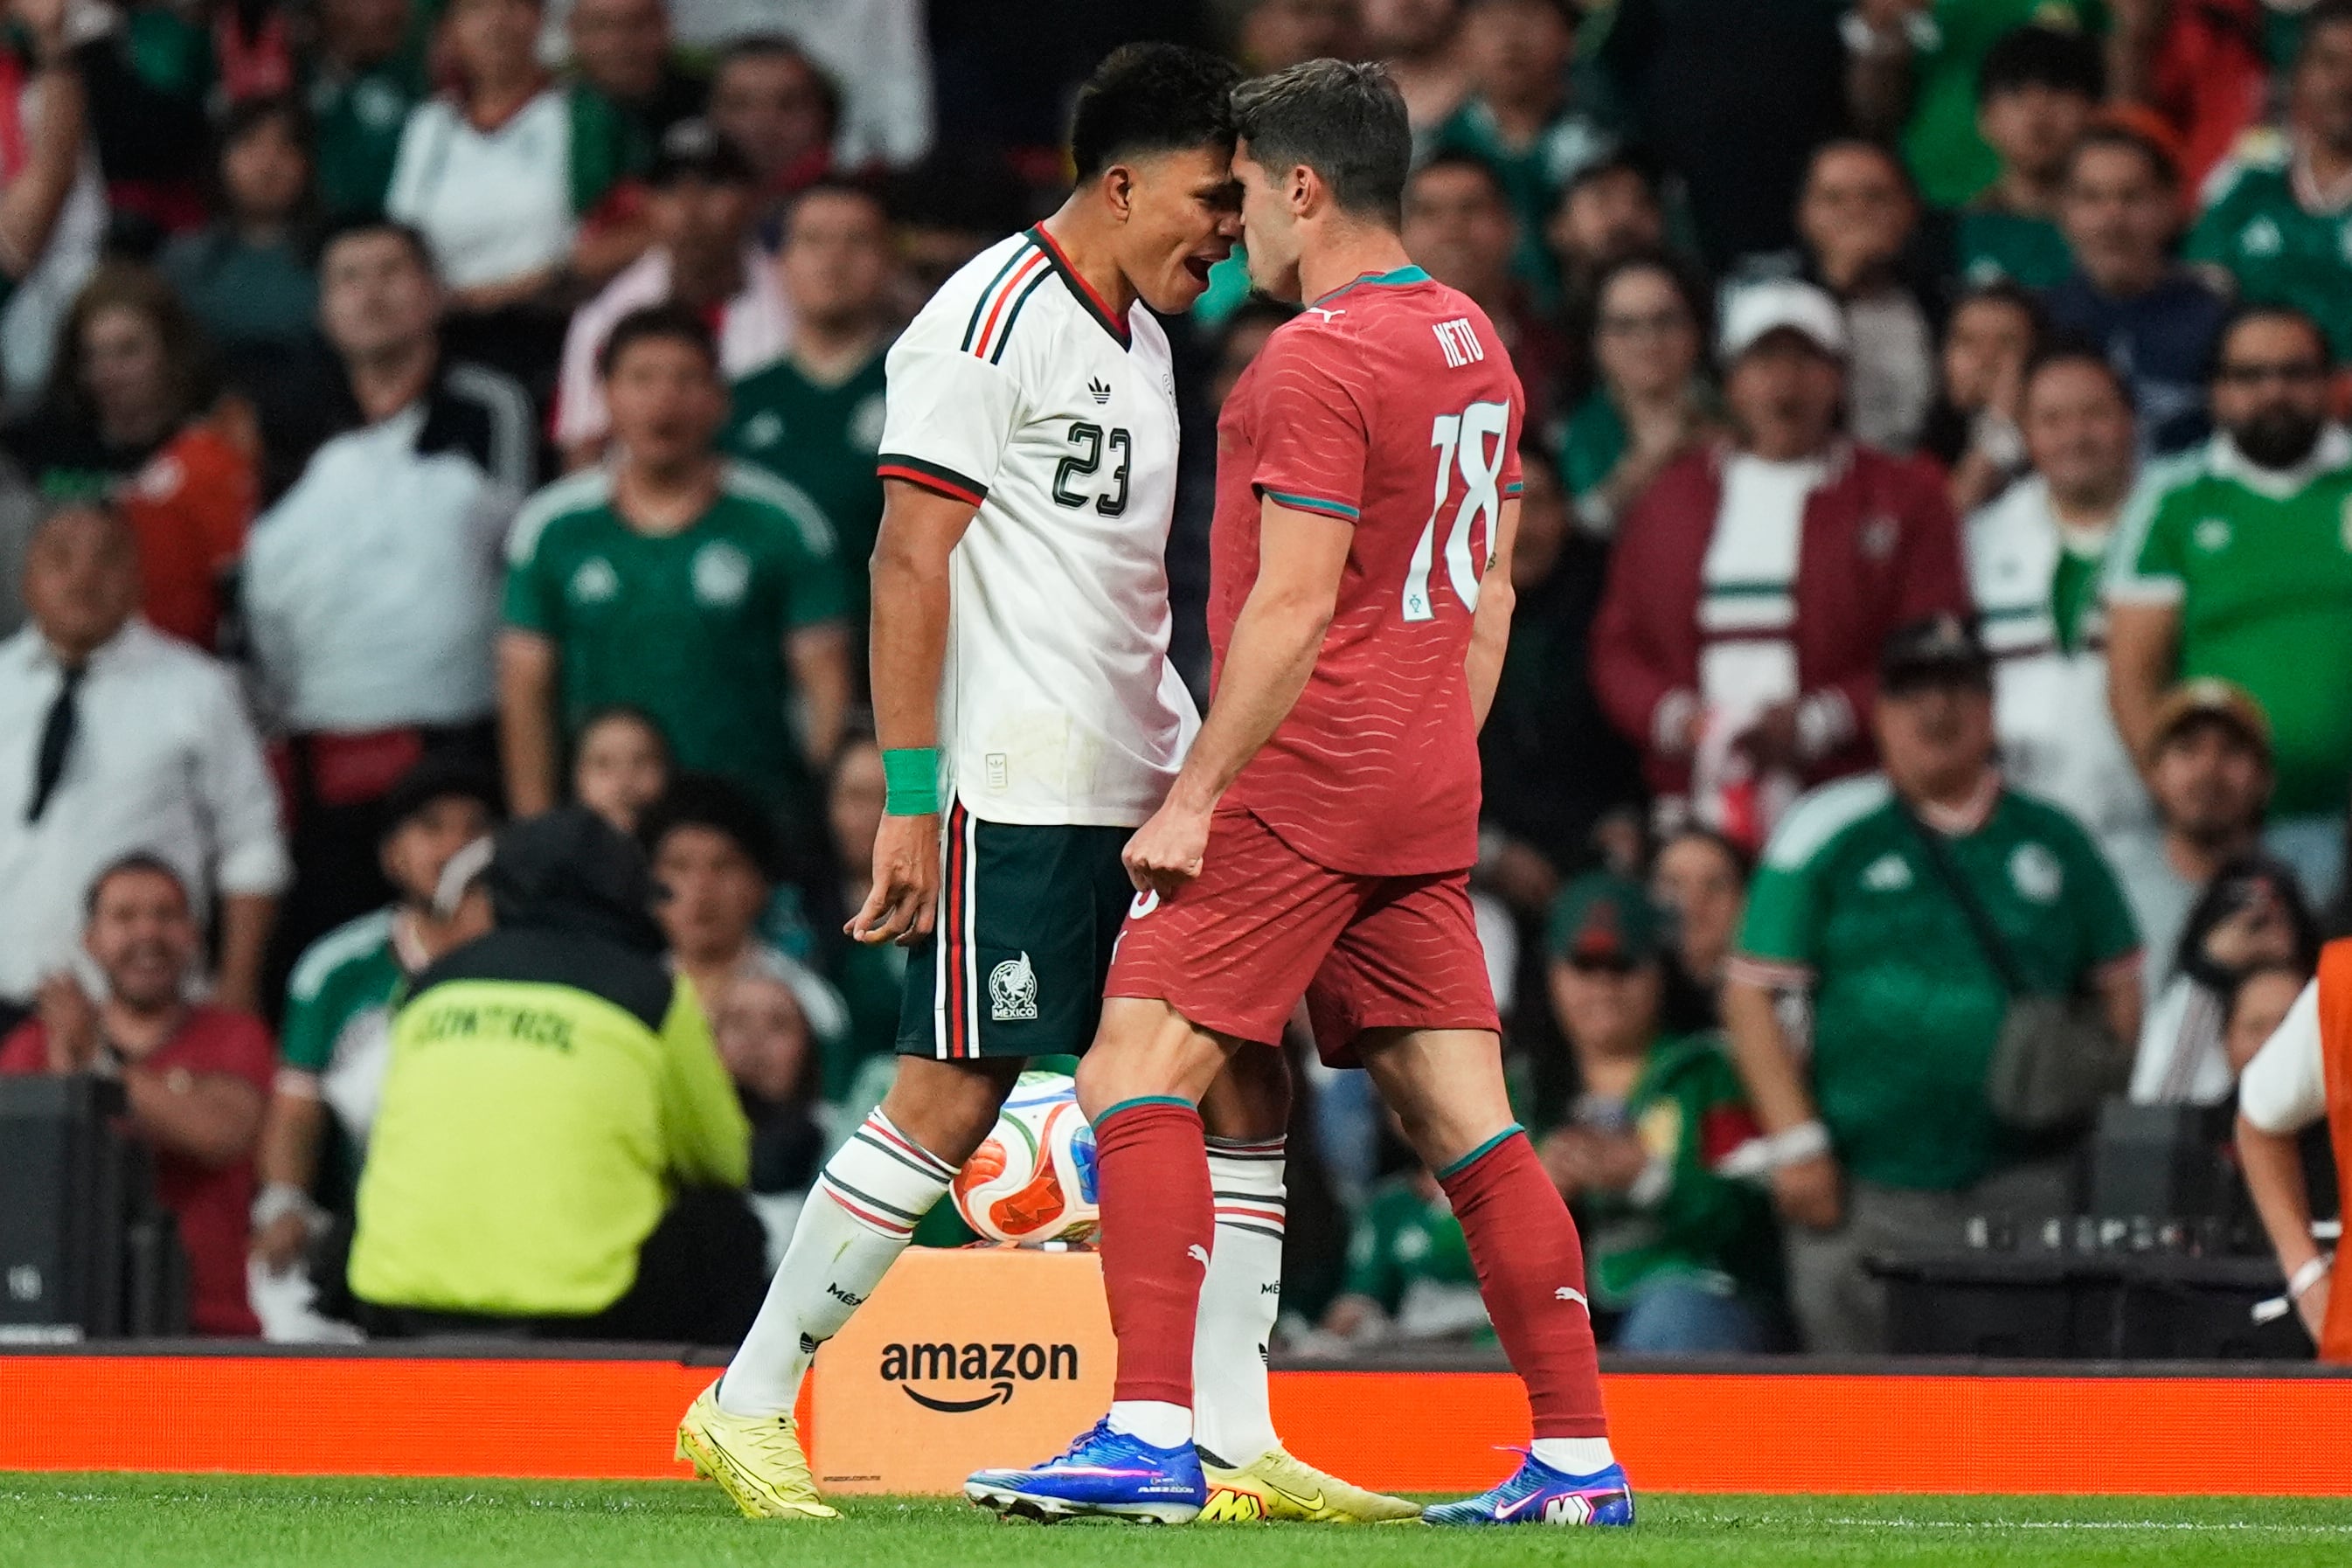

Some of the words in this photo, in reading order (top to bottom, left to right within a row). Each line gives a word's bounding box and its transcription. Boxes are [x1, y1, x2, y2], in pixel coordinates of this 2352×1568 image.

[1432, 317, 1484, 368] NETO
[1052, 421, 1132, 518] 23
[1402, 399, 1510, 622] 18
[880, 1343, 1078, 1381] amazon
